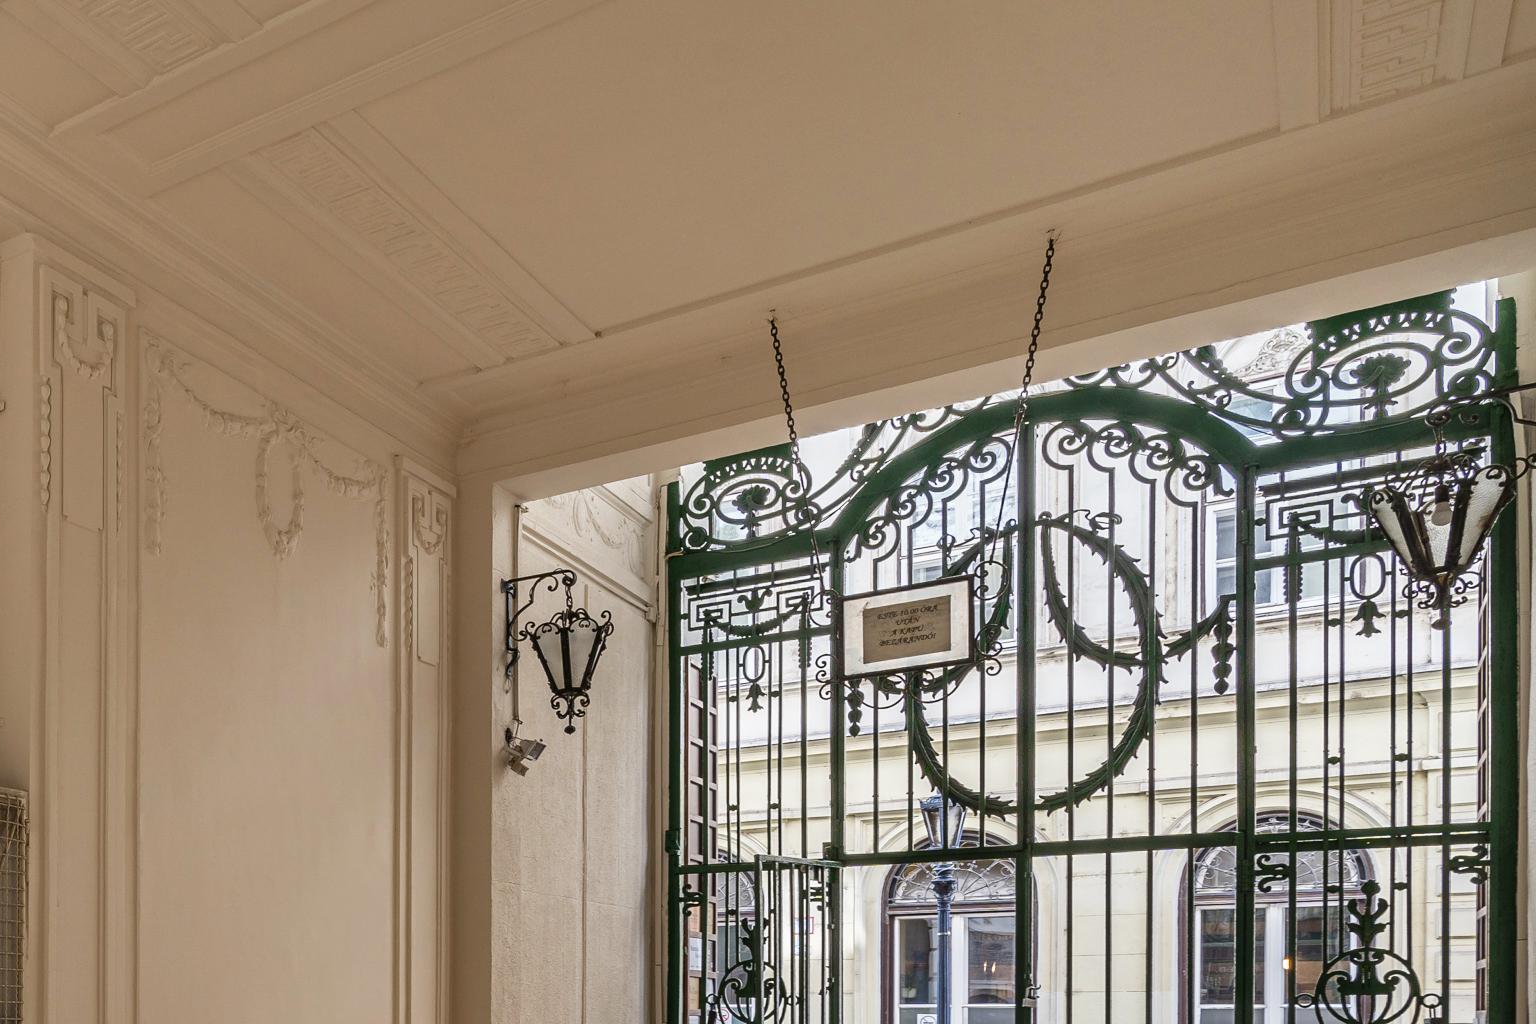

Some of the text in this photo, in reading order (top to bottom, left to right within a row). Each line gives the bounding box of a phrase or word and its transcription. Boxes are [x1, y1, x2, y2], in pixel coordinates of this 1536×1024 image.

[877, 604, 941, 620] ESTE 10.00 ÓRA
[895, 616, 921, 626] UTÁN
[890, 625, 924, 637] A KAPU
[879, 632, 937, 647] BEZÁRANDÓ!
